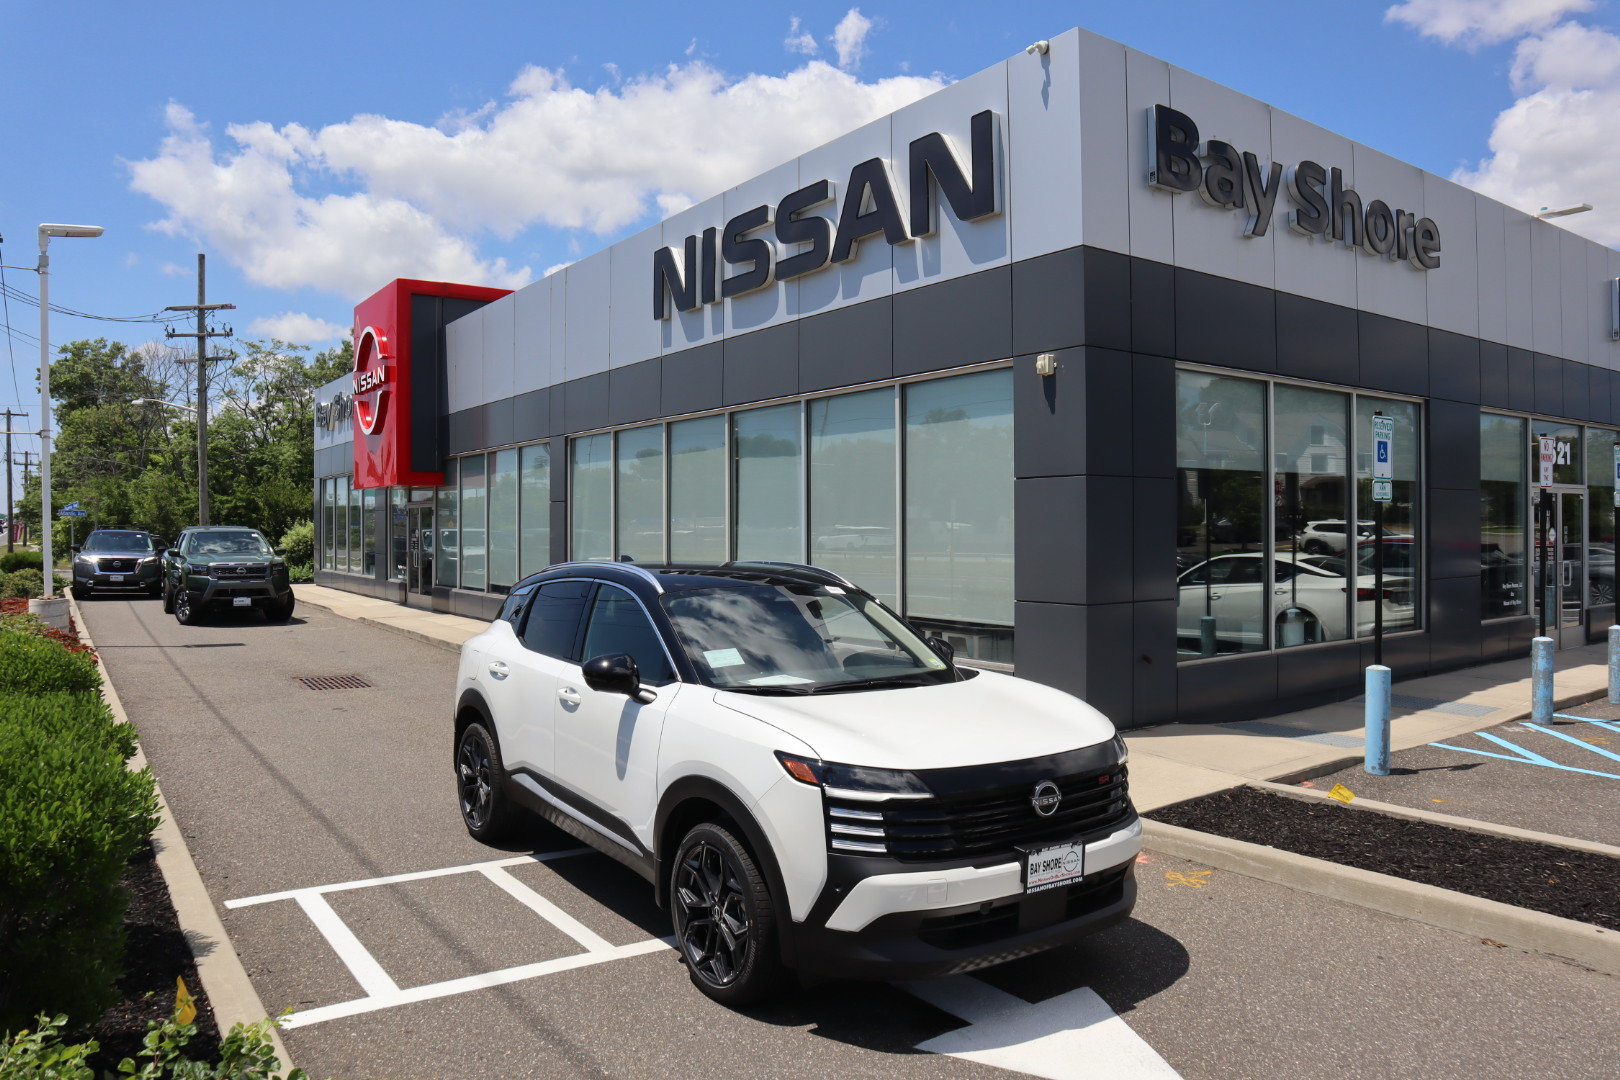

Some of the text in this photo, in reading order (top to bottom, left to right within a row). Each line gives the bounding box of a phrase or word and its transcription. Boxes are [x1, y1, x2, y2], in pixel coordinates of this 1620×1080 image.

[1146, 104, 1441, 271] Bay Shore
[653, 109, 1000, 320] NISSAN
[353, 365, 384, 394] NISSAN
[1375, 431, 1391, 441] PARKING
[1031, 794, 1062, 806] NISSAN
[1030, 861, 1042, 876] BAY
[1042, 857, 1062, 873] SHORE
